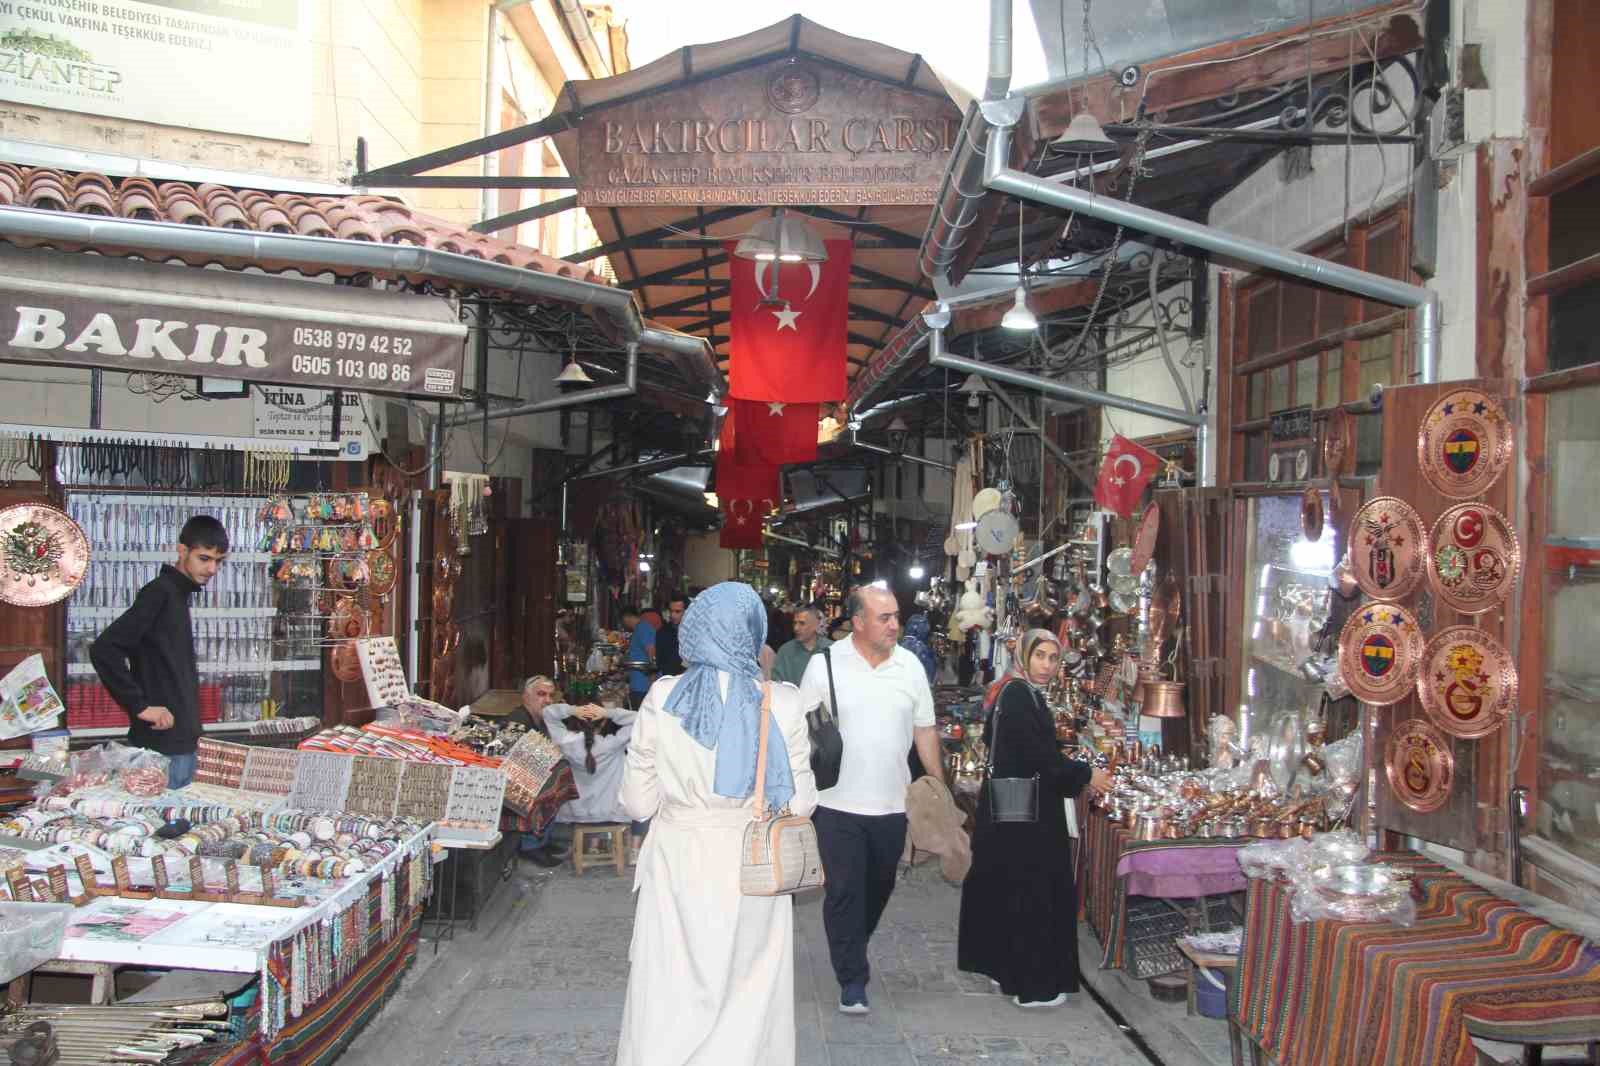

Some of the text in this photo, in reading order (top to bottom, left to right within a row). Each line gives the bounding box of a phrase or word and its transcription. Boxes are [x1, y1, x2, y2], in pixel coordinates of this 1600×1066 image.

[0, 2, 13, 14] YI
[59, 14, 108, 32] VAKFINA
[112, 23, 166, 43] TEŞEKKÜR
[30, 0, 98, 15] ÜKŞEHİR
[102, 6, 162, 26] BELEDİYESİ
[603, 118, 832, 153] BAKIRCILAR
[8, 305, 270, 369] BAKIR
[293, 327, 412, 356] 0538 979 42 52
[292, 354, 331, 375] 0505
[336, 358, 365, 378] 103
[368, 362, 387, 381] 08
[391, 364, 411, 382] 86
